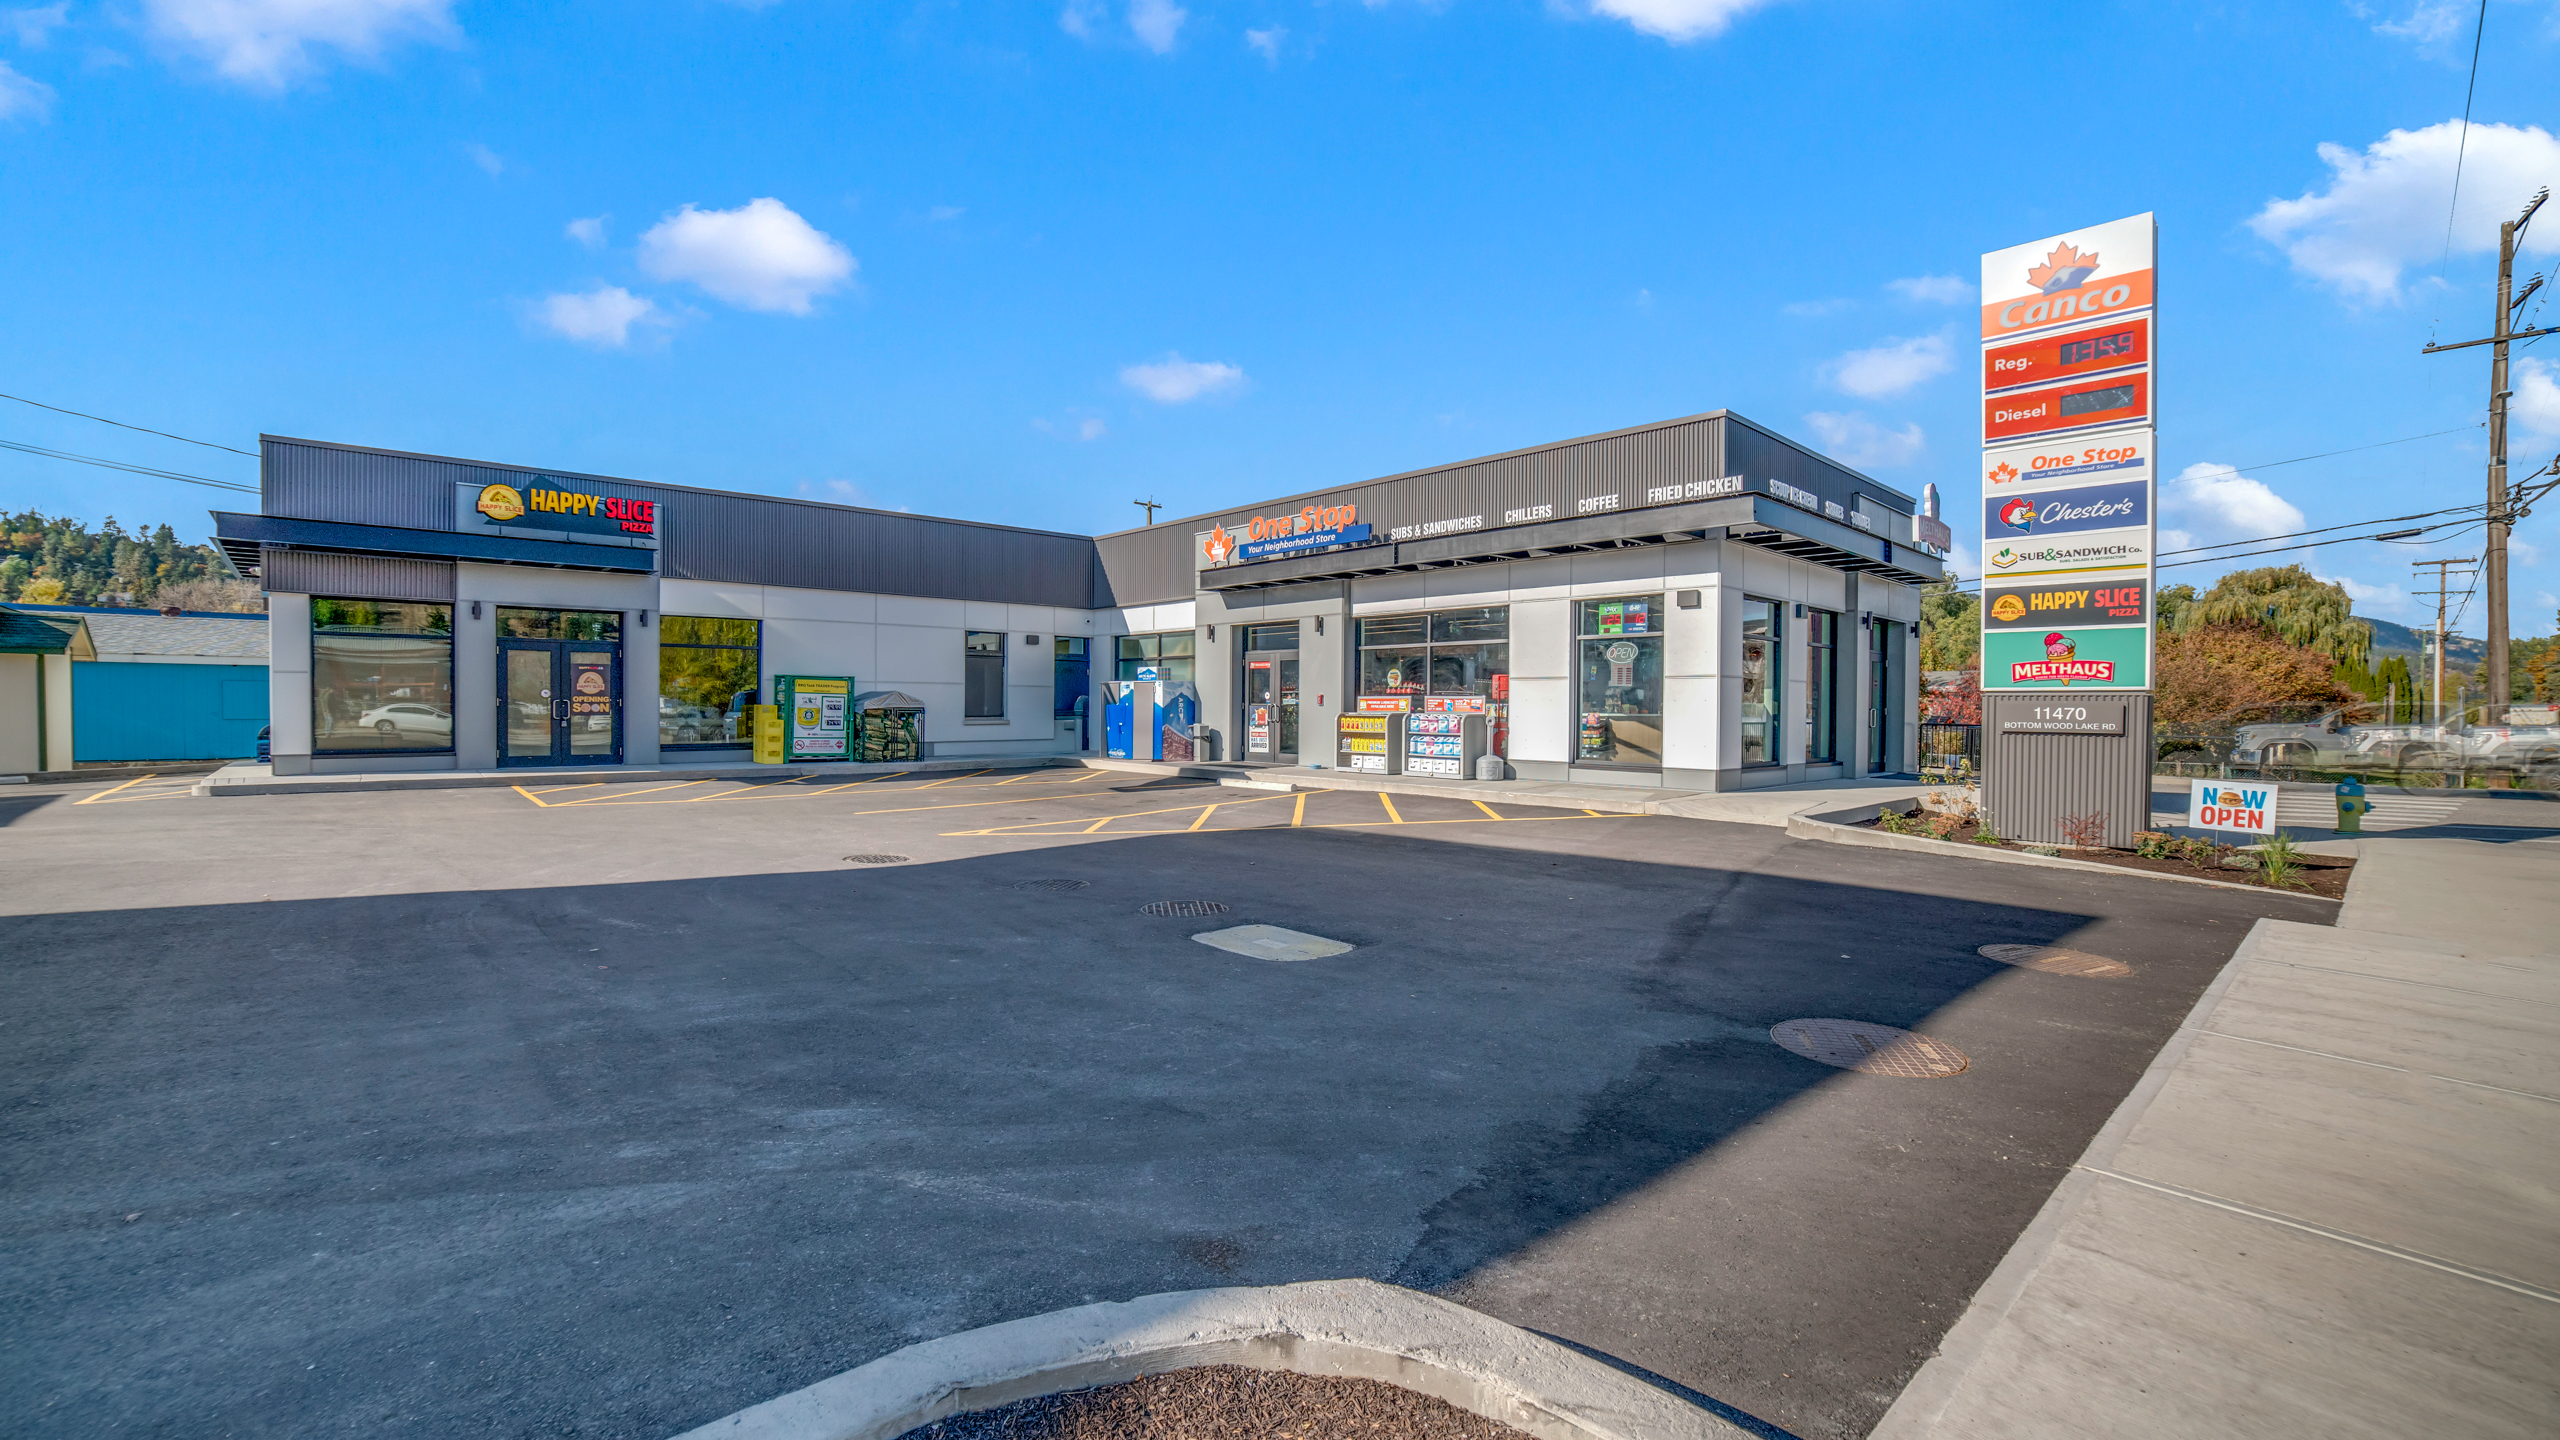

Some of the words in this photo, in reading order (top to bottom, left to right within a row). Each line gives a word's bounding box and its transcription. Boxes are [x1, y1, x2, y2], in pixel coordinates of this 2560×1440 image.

[1999, 284, 2131, 329] Canco
[1995, 357, 2033, 371] Reg.
[1995, 403, 2047, 423] Diesel
[2031, 455, 2074, 470] One
[2082, 446, 2136, 464] Stop
[2047, 466, 2095, 476] Neighborhood
[1648, 485, 1683, 503] FRIED
[1685, 475, 1743, 498] CHICKEN
[480, 503, 502, 511] HAPPY
[504, 505, 522, 513] SLICE
[530, 488, 600, 517] HAPPY
[605, 496, 654, 523] SLICE
[1578, 494, 1619, 513] COFFEE
[2039, 498, 2134, 524] Chester's
[1248, 516, 1292, 541] One
[1298, 504, 1357, 533] Stop
[1505, 504, 1553, 523] CHILLERS
[621, 521, 654, 534] PIZZA
[1390, 526, 1413, 540] SUBS
[1414, 524, 1421, 536] &
[1423, 515, 1483, 535] SANDWICHES
[1919, 517, 1950, 548] MELTHAUS
[1247, 545, 1264, 554] Your
[1264, 535, 1314, 552] Neighborhood
[1315, 533, 1336, 543] Store
[2030, 590, 2090, 611] HAPPY
[2094, 587, 2141, 608] SLICE
[1606, 614, 1621, 625] 25
[1635, 612, 1646, 623] 12
[2108, 607, 2140, 617] PIZZA
[1608, 647, 1636, 658] OPEN
[2014, 663, 2110, 679] MELTHAUS
[2033, 707, 2087, 721] 11470
[2043, 722, 2073, 730] WOOD
[2075, 722, 2100, 730] LAKE
[2102, 723, 2118, 731] RD.
[2200, 806, 2264, 829] OPEN
